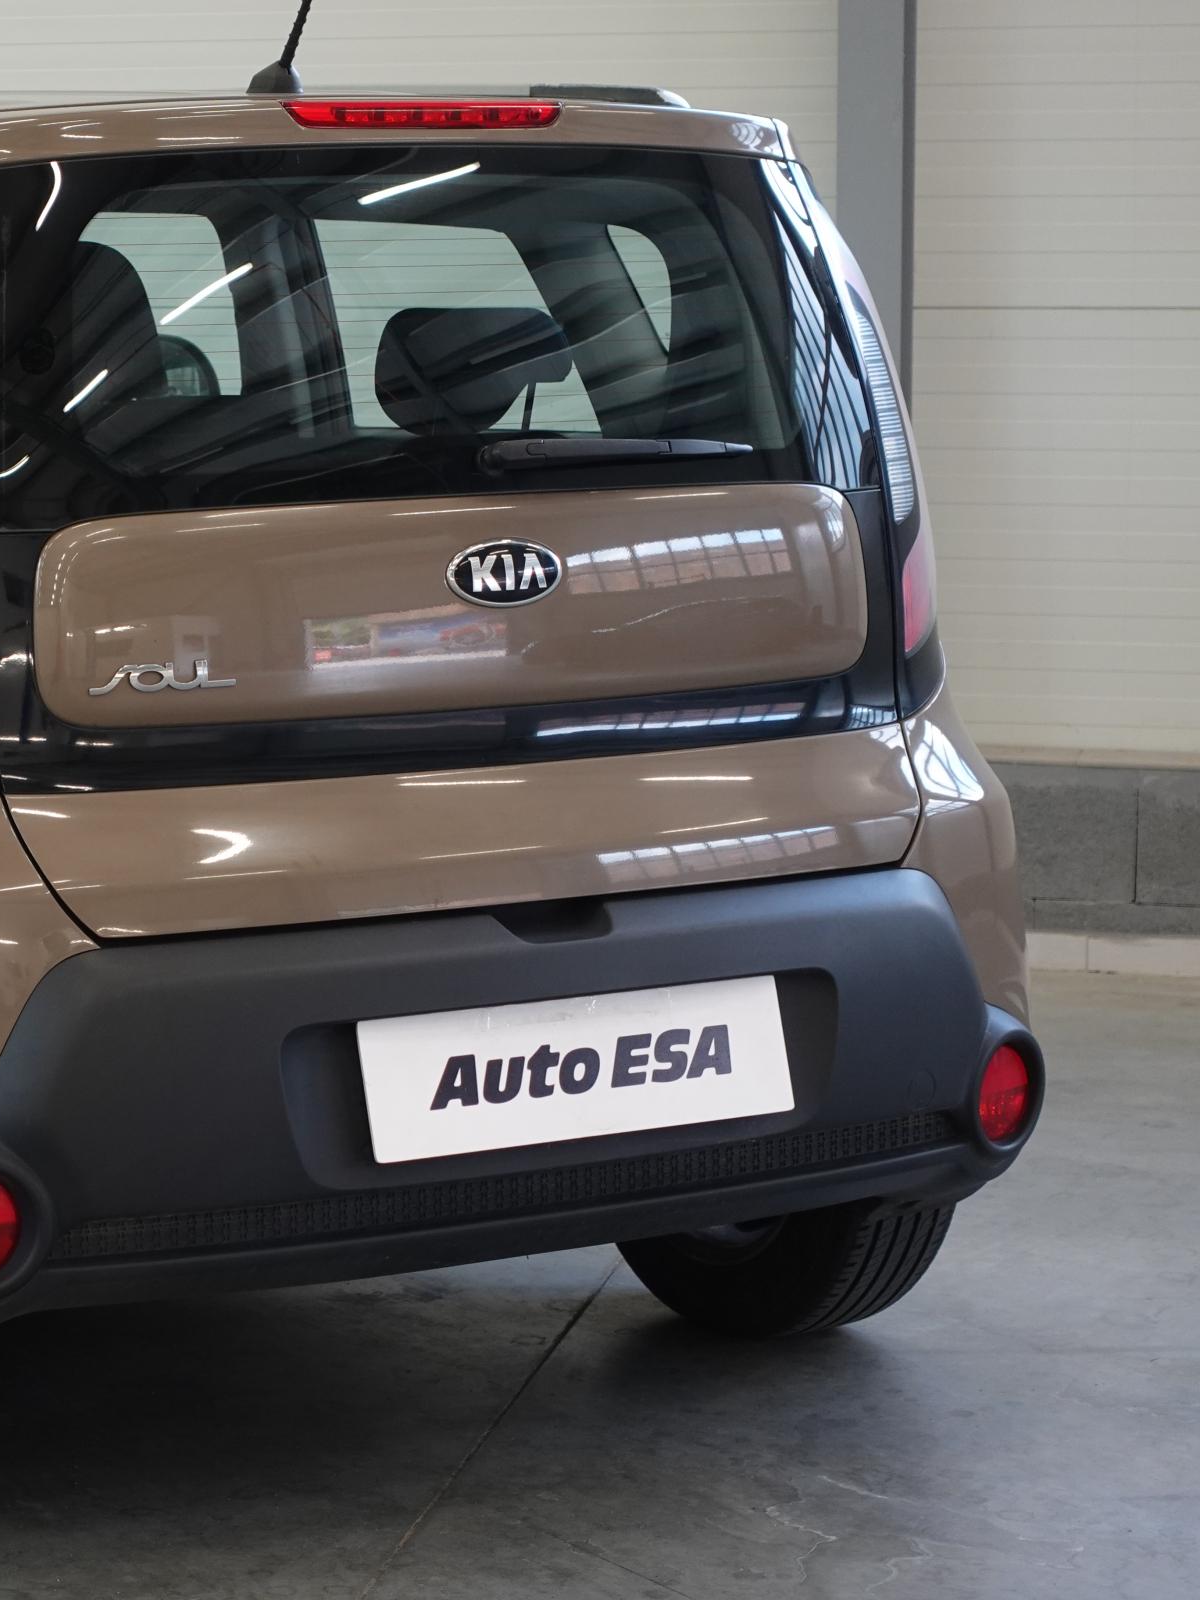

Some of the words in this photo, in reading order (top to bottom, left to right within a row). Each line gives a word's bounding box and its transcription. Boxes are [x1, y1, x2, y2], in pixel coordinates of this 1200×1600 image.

[467, 552, 548, 593] KIA
[429, 1044, 601, 1112] Auto
[610, 1023, 733, 1089] ESA
